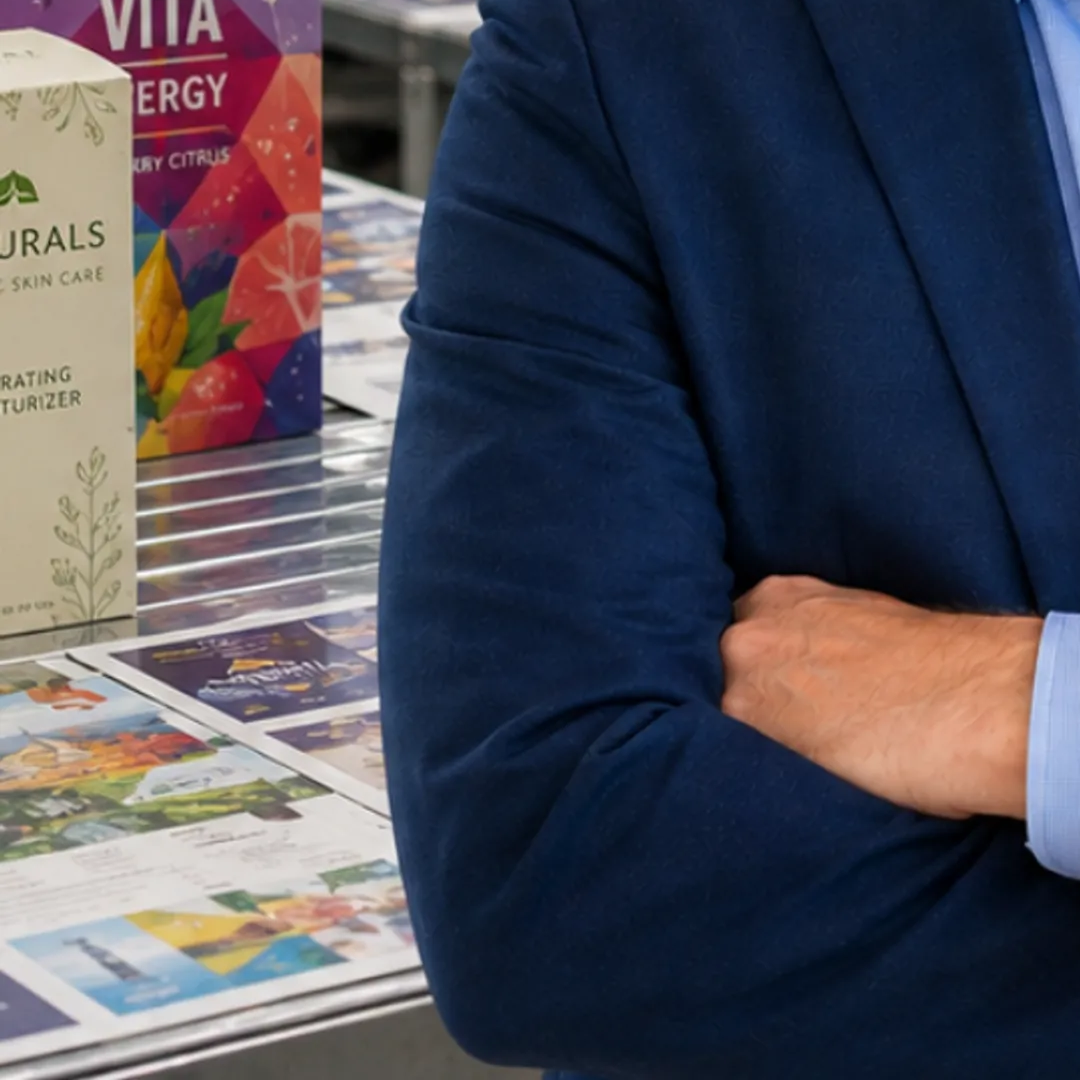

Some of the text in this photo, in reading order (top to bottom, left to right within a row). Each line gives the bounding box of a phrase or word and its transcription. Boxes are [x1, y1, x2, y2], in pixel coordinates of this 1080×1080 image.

[137, 72, 228, 116] ERGY
[168, 146, 231, 170] CITRUS
[0, 220, 105, 260] URALS
[12, 273, 53, 292] SKIN
[60, 266, 104, 286] CARE
[0, 365, 71, 390] RATING
[0, 389, 81, 415] TURIZER
